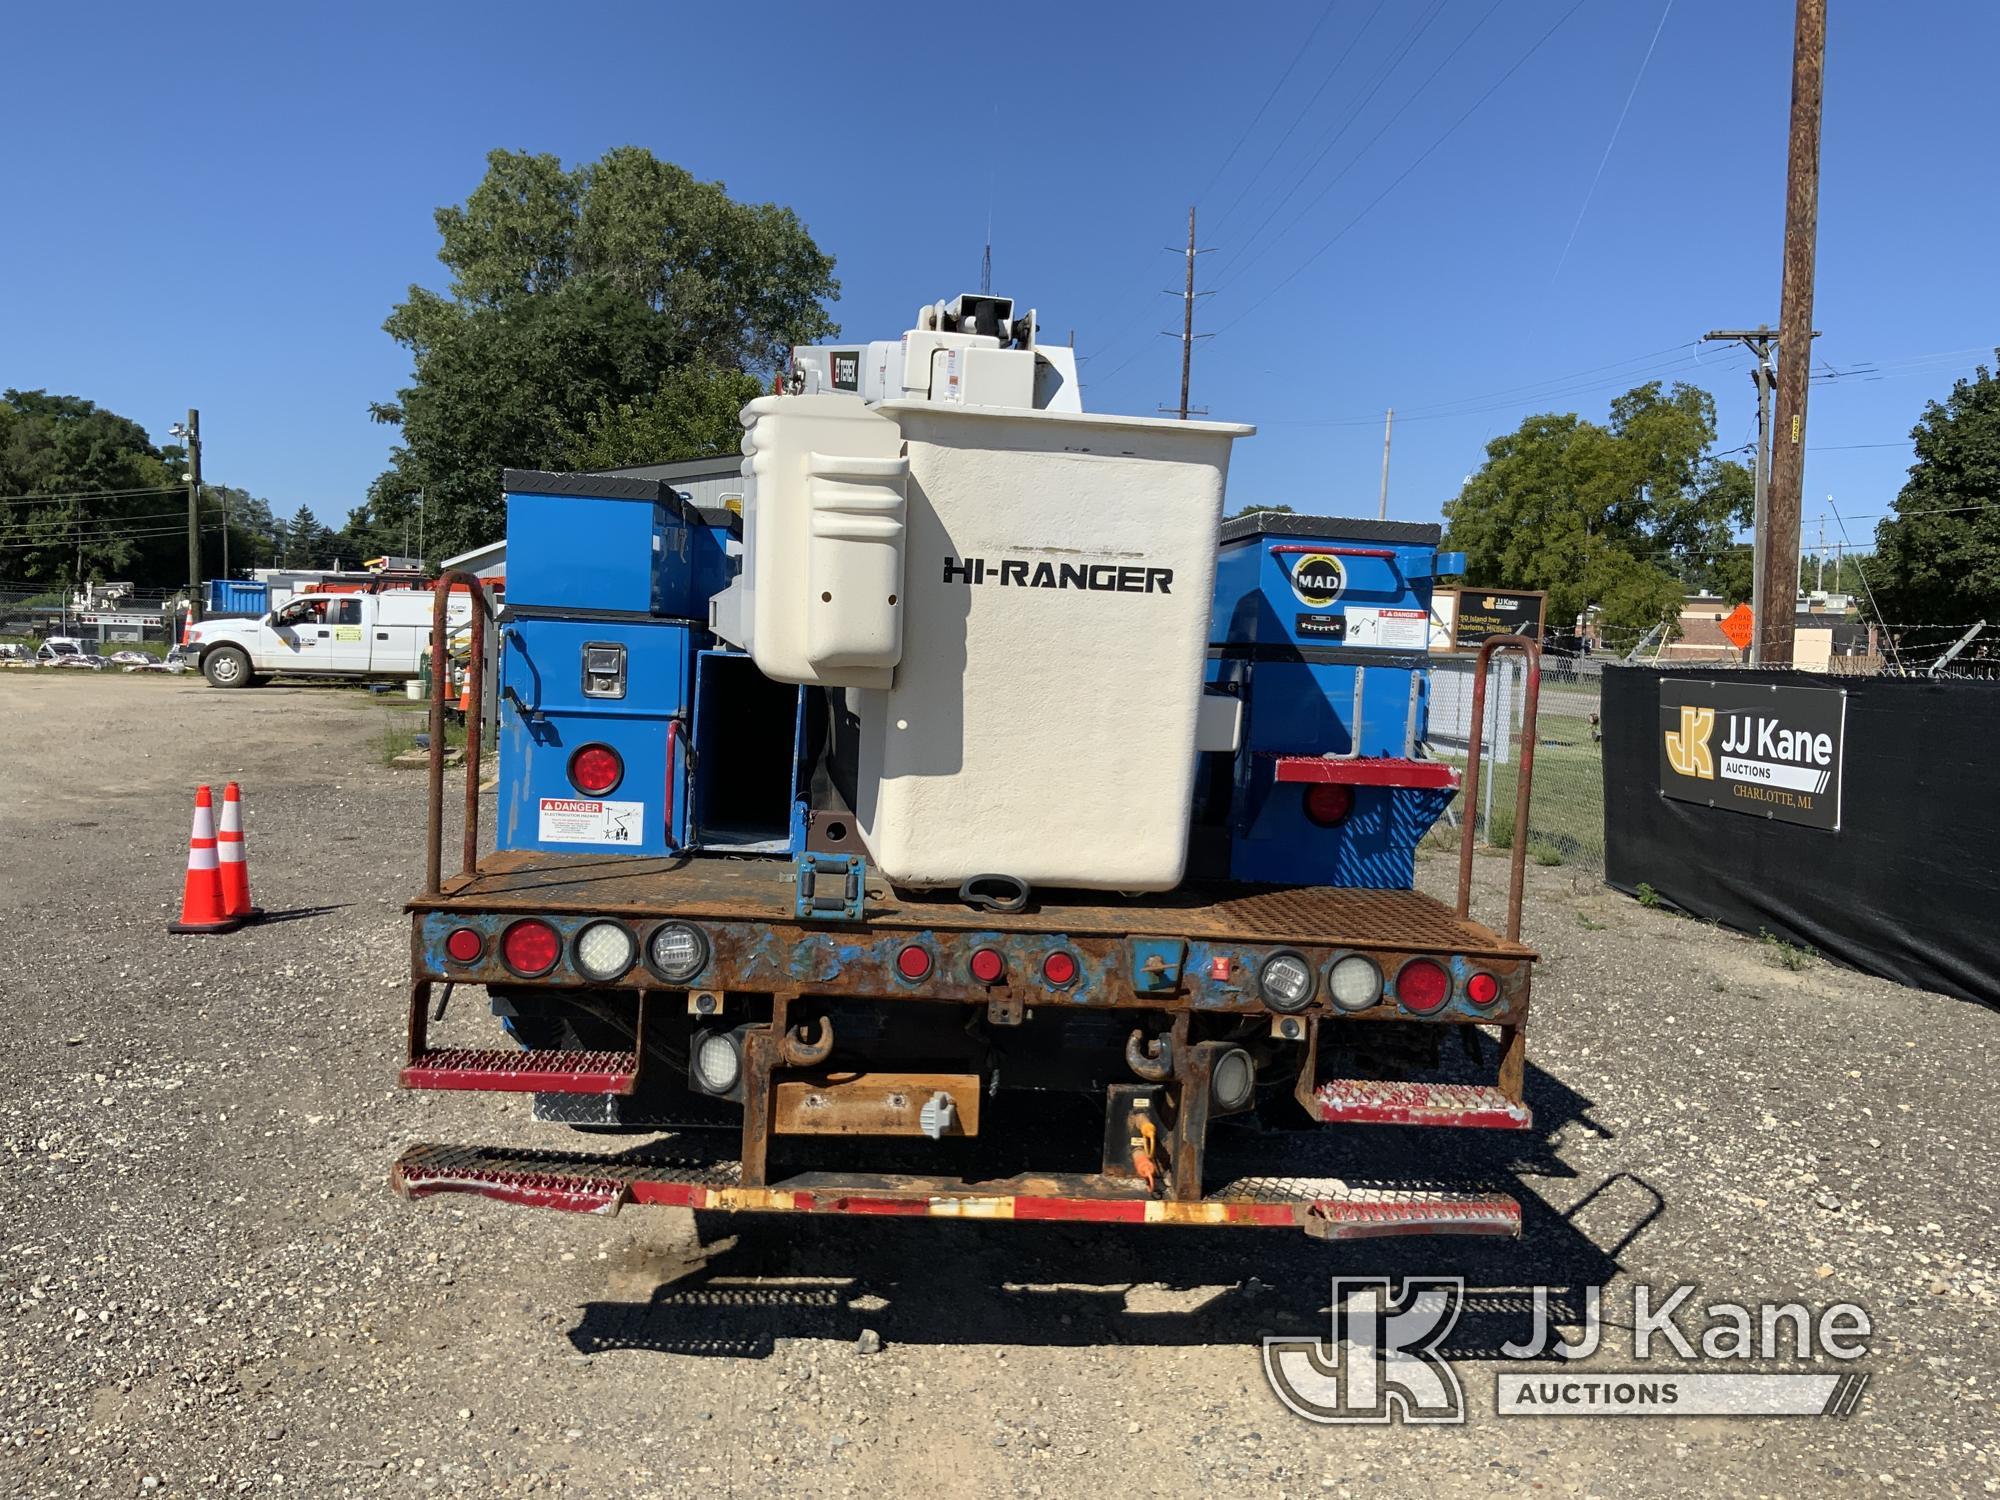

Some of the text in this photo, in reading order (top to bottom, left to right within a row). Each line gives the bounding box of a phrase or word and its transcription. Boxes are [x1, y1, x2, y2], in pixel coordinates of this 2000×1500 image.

[840, 359, 857, 383] TEREX
[943, 556, 1174, 594] HI-RANGER
[1503, 598, 1518, 606] Kane
[1392, 610, 1418, 618] DANGER
[1721, 715, 1833, 766] JJ Kane
[1725, 761, 1771, 779] AUCTIONS
[1733, 784, 1796, 808] CHARLOTTE,
[554, 802, 600, 812] DANGER
